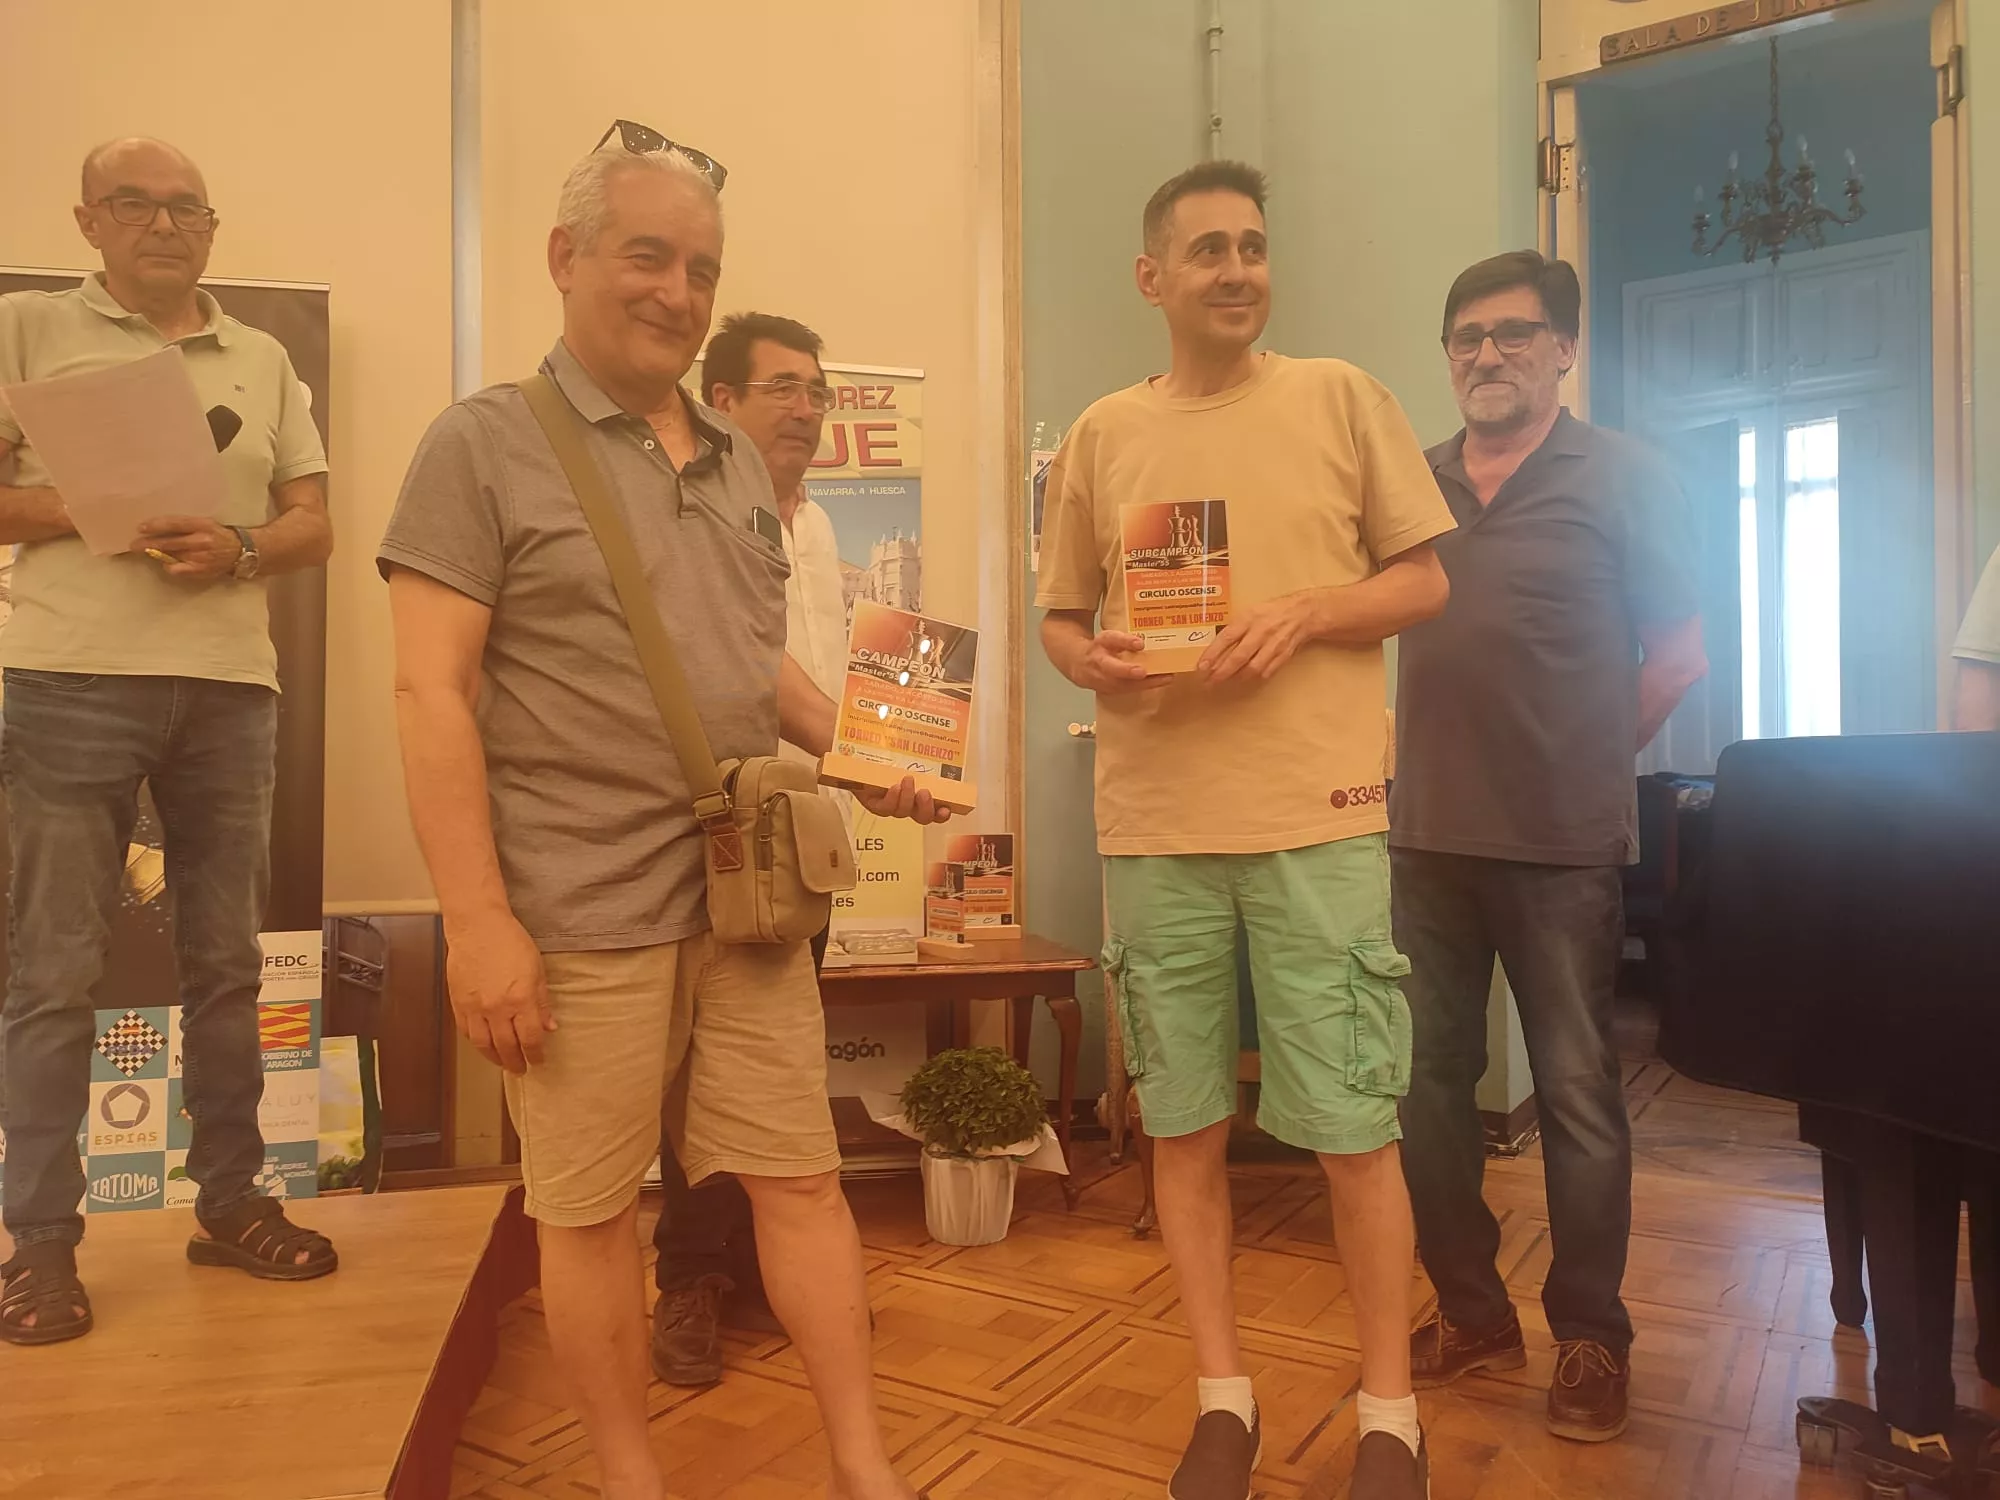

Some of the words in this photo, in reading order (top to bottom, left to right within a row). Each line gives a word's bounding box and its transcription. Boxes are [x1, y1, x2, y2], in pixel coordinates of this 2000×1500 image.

[1605, 24, 1681, 58] SALA
[1695, 10, 1730, 37] DE
[859, 487, 865, 495] 4
[870, 487, 906, 495] HUESCA
[1139, 590, 1176, 599] CIRCULO
[1178, 586, 1217, 596] OSCENSE
[1133, 616, 1164, 628] TORNEO
[857, 699, 904, 716] CIRCLO
[904, 709, 951, 728] OSCENSE
[264, 954, 308, 968] FEDC
[301, 1050, 312, 1058] DE
[92, 1173, 158, 1198] TATOMA
